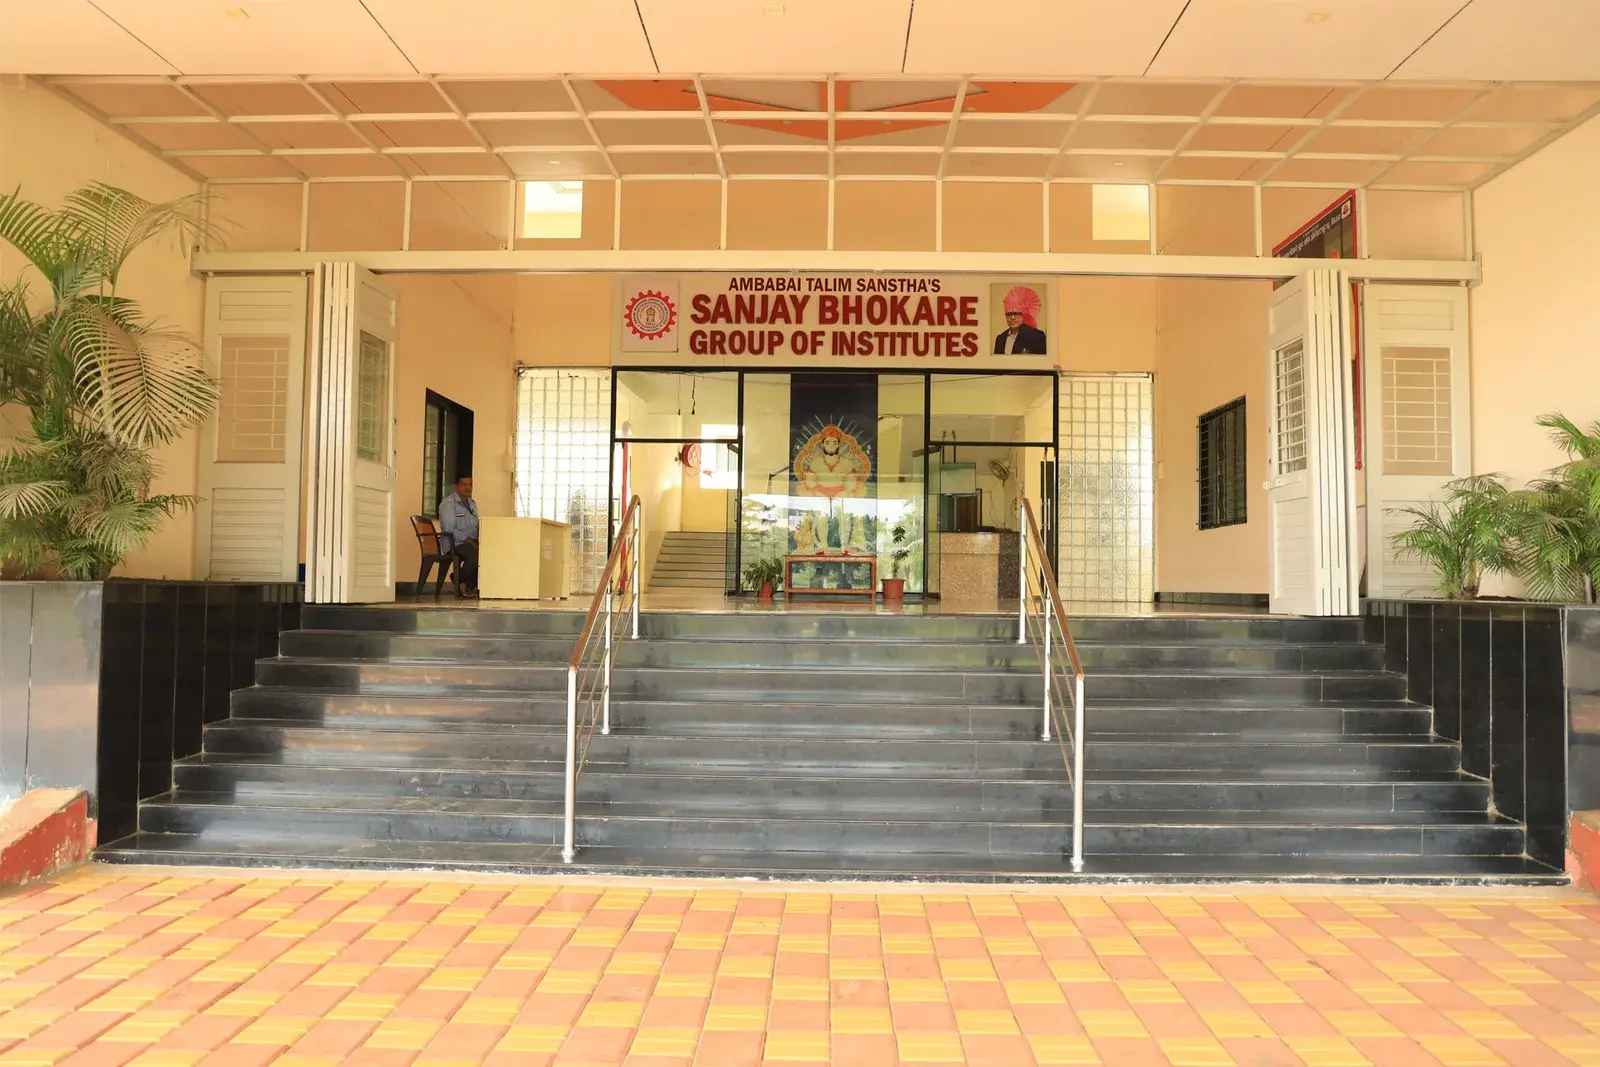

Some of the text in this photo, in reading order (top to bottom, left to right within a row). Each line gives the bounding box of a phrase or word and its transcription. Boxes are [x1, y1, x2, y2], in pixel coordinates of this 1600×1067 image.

[728, 277, 941, 293] AMBABAI TALIM SANSTHA'S
[690, 293, 811, 325] SANJAY
[818, 294, 979, 327] BHOKARE
[689, 329, 979, 358] GROUP OF INSTITUTES
